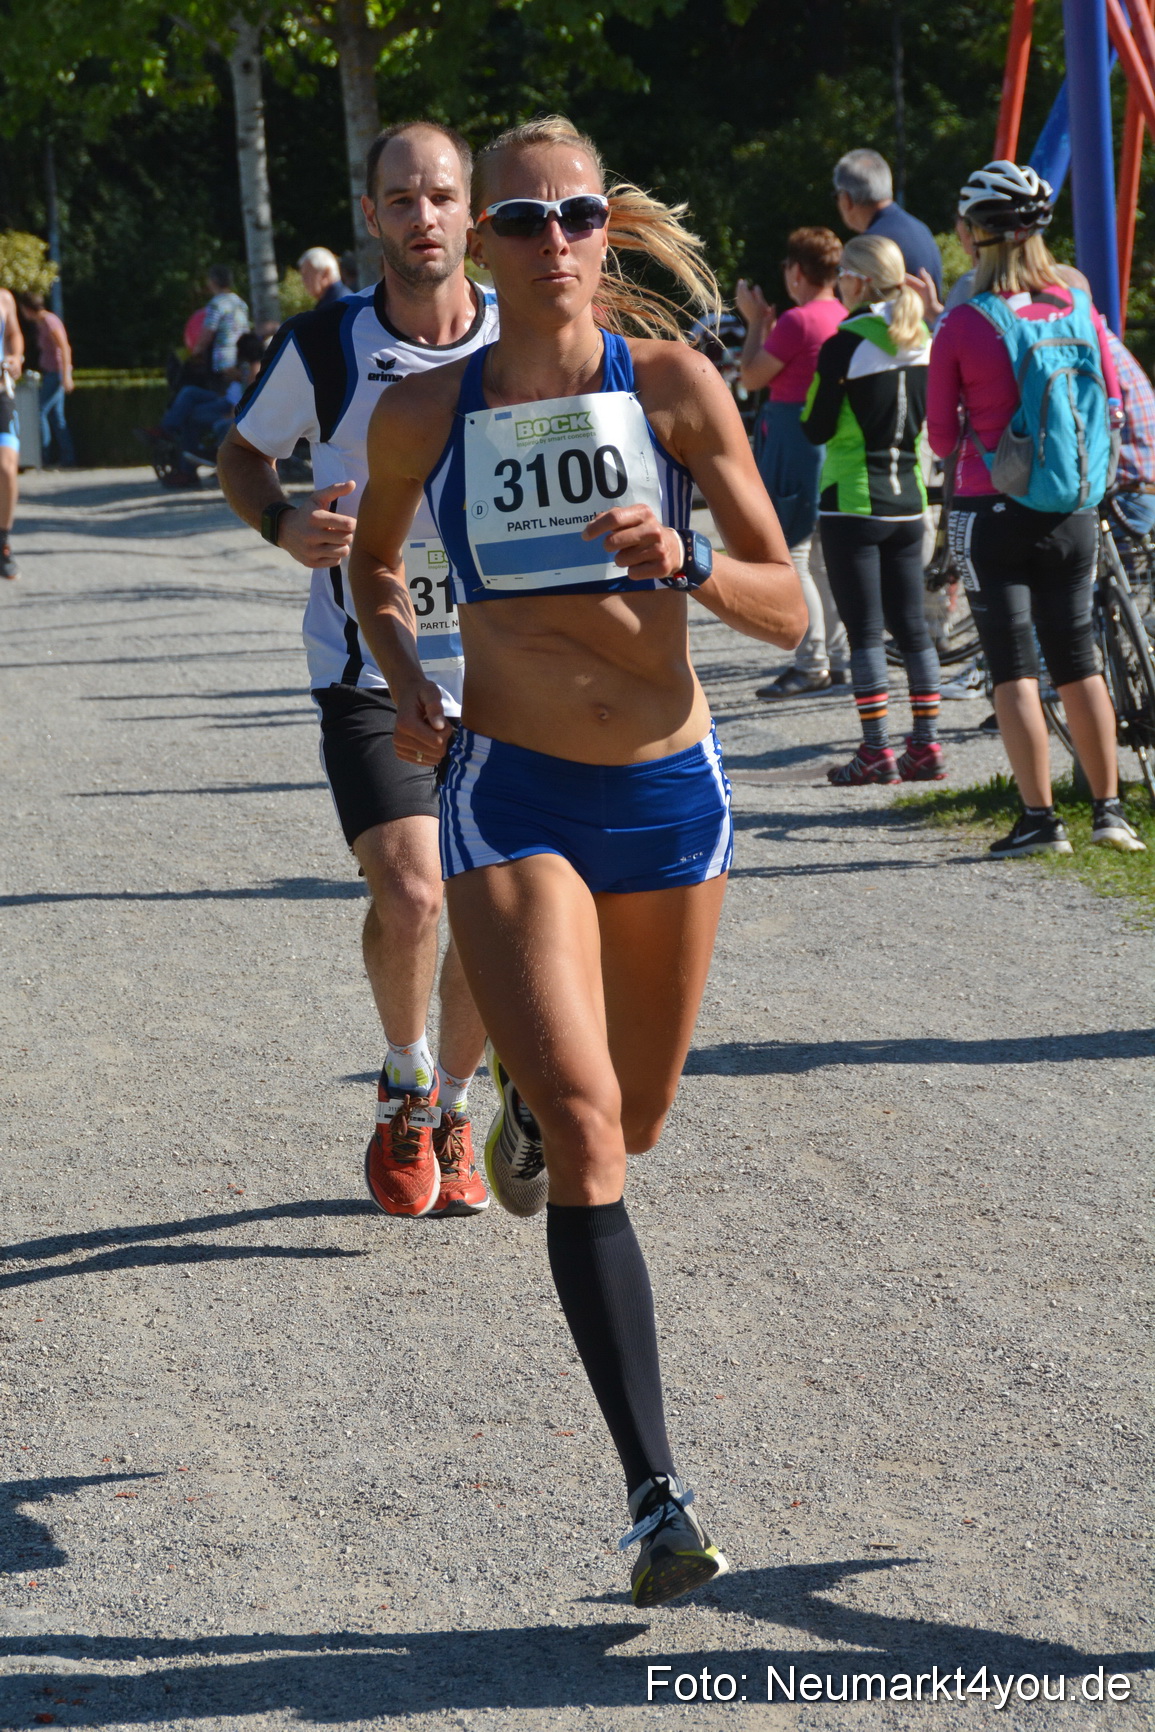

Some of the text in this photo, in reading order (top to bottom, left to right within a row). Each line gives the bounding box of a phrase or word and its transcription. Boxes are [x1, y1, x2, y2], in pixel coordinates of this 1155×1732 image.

[367, 371, 404, 382] erima
[515, 411, 594, 441] BOCK
[547, 435, 566, 443] smart
[567, 431, 597, 440] concepts
[493, 444, 629, 513] 3100
[507, 519, 547, 532] PARTL
[420, 621, 450, 630] PARTL
